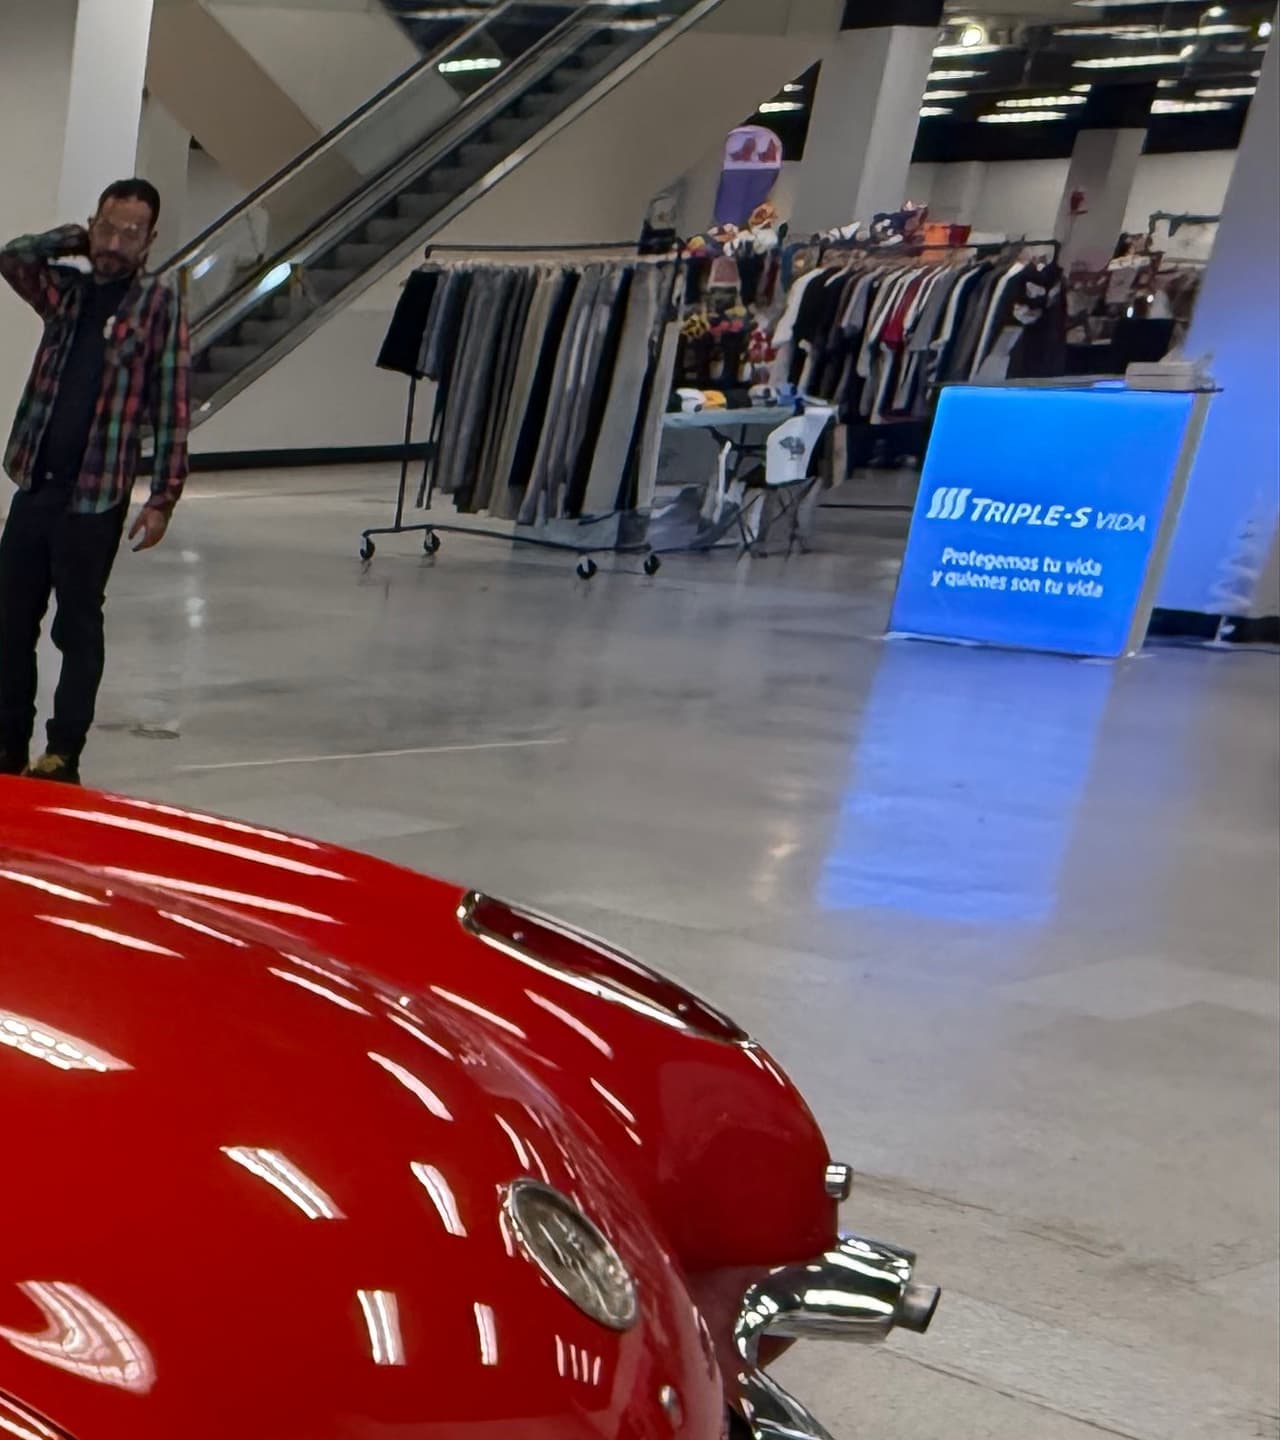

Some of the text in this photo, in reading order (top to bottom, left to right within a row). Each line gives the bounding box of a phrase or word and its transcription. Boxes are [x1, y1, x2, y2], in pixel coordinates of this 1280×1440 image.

[1095, 511, 1146, 532] VIDA
[942, 547, 1102, 577] Protegemos tu vida
[931, 569, 1104, 598] y quienes son tu vida
